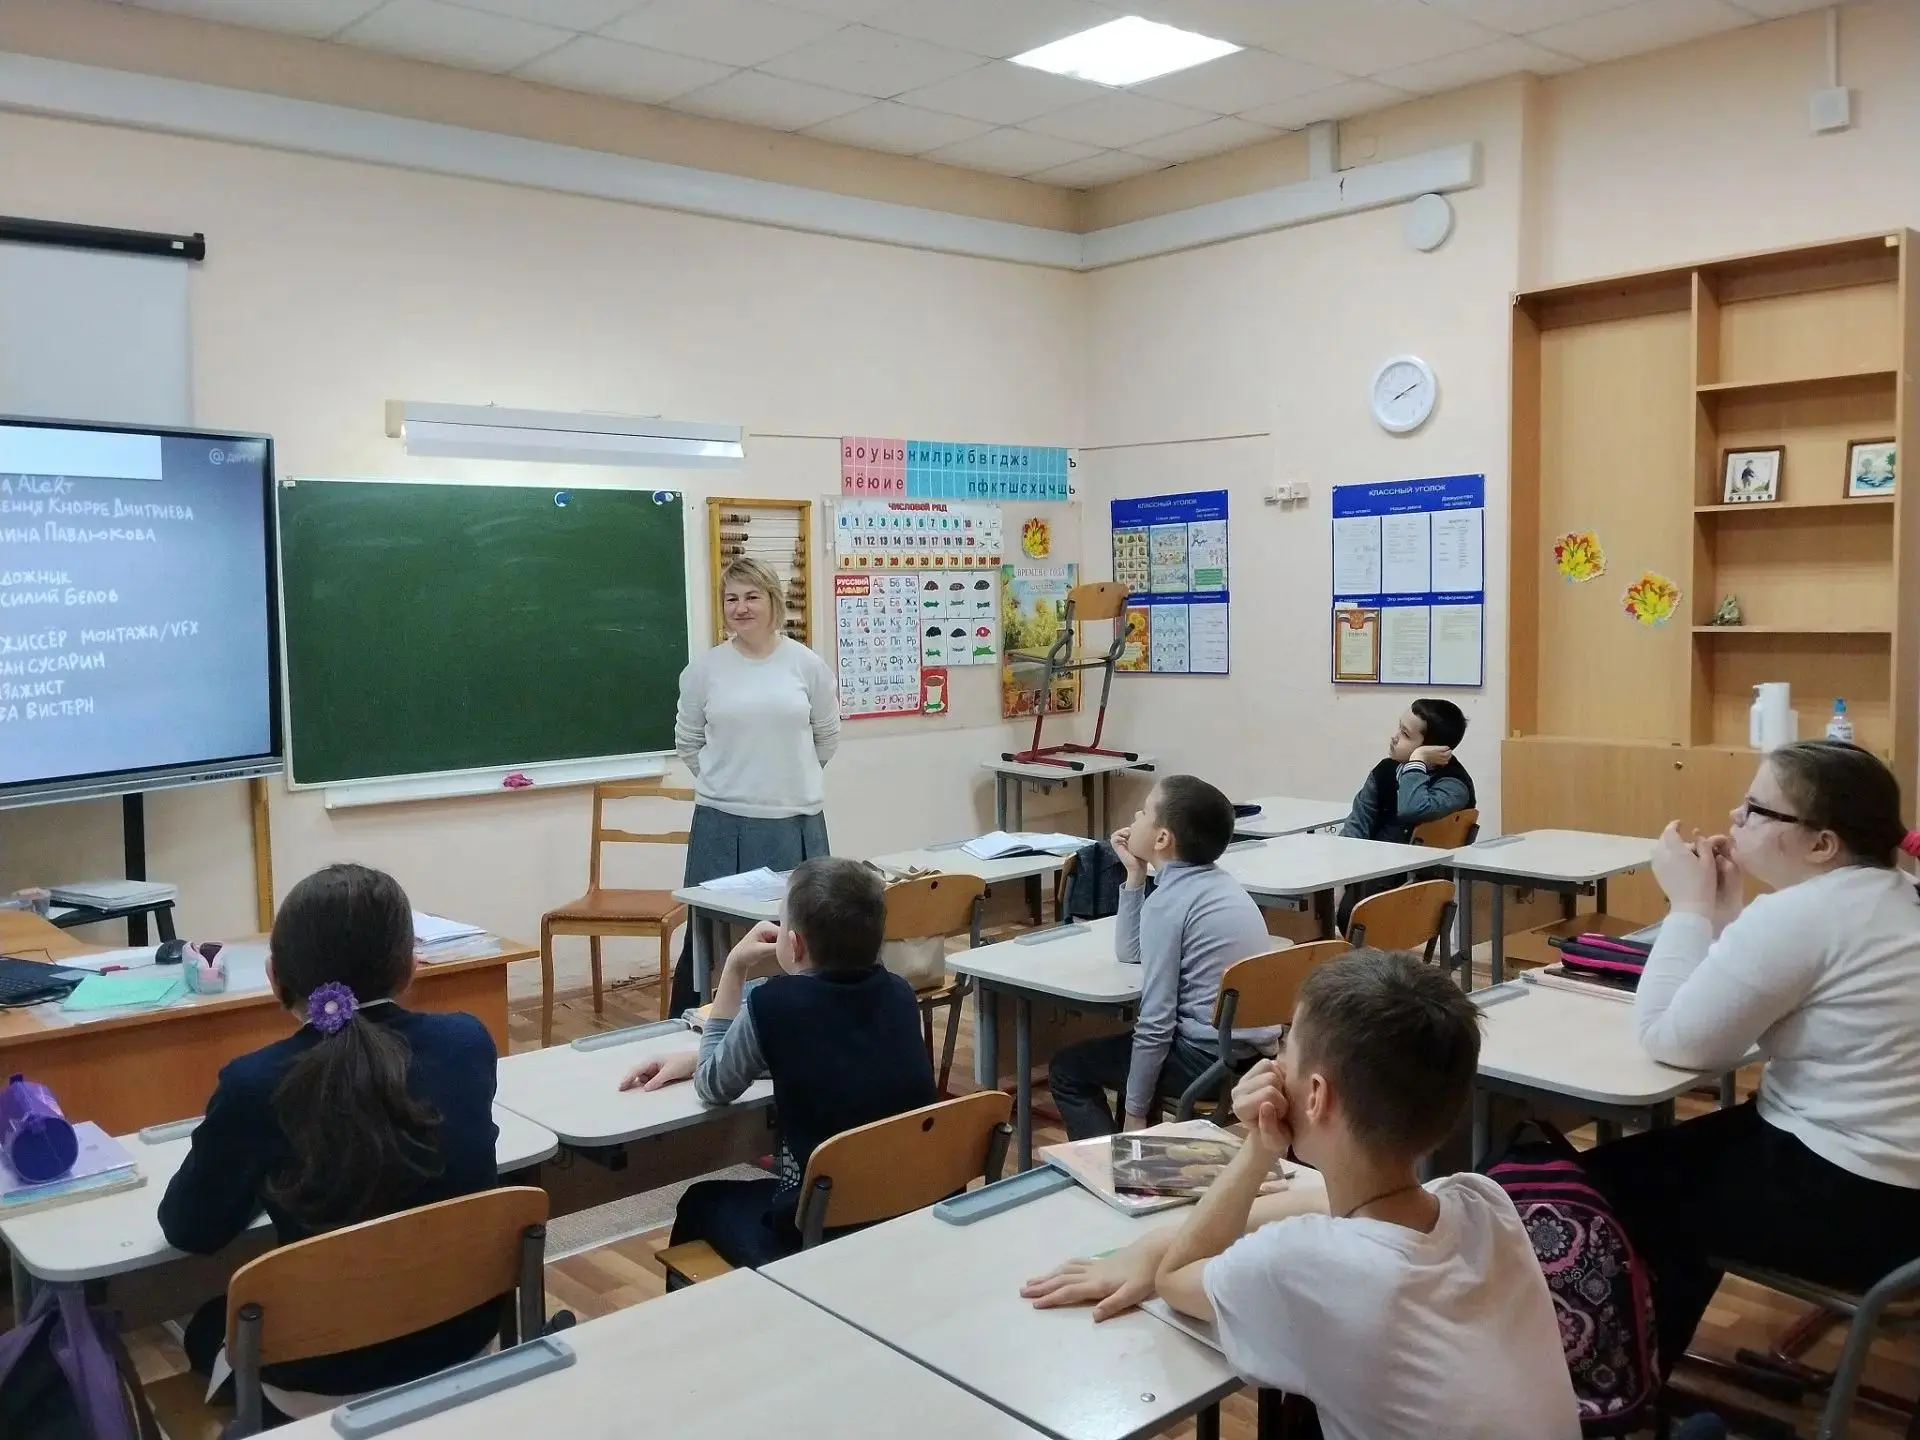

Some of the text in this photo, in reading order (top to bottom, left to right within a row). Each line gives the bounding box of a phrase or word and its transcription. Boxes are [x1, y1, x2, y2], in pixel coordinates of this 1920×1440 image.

[1368, 484, 1446, 497] КЛАССНЫЙ УГОЛОК
[0, 499, 44, 517] ЕНИЯ
[44, 521, 156, 544] ПАВЛЮКОВА
[836, 577, 869, 586] РУССКИЙ
[64, 587, 119, 606] БЕЛОВ
[27, 650, 106, 675] СУСАРИН
[26, 696, 95, 720] ВИСТЕРН
